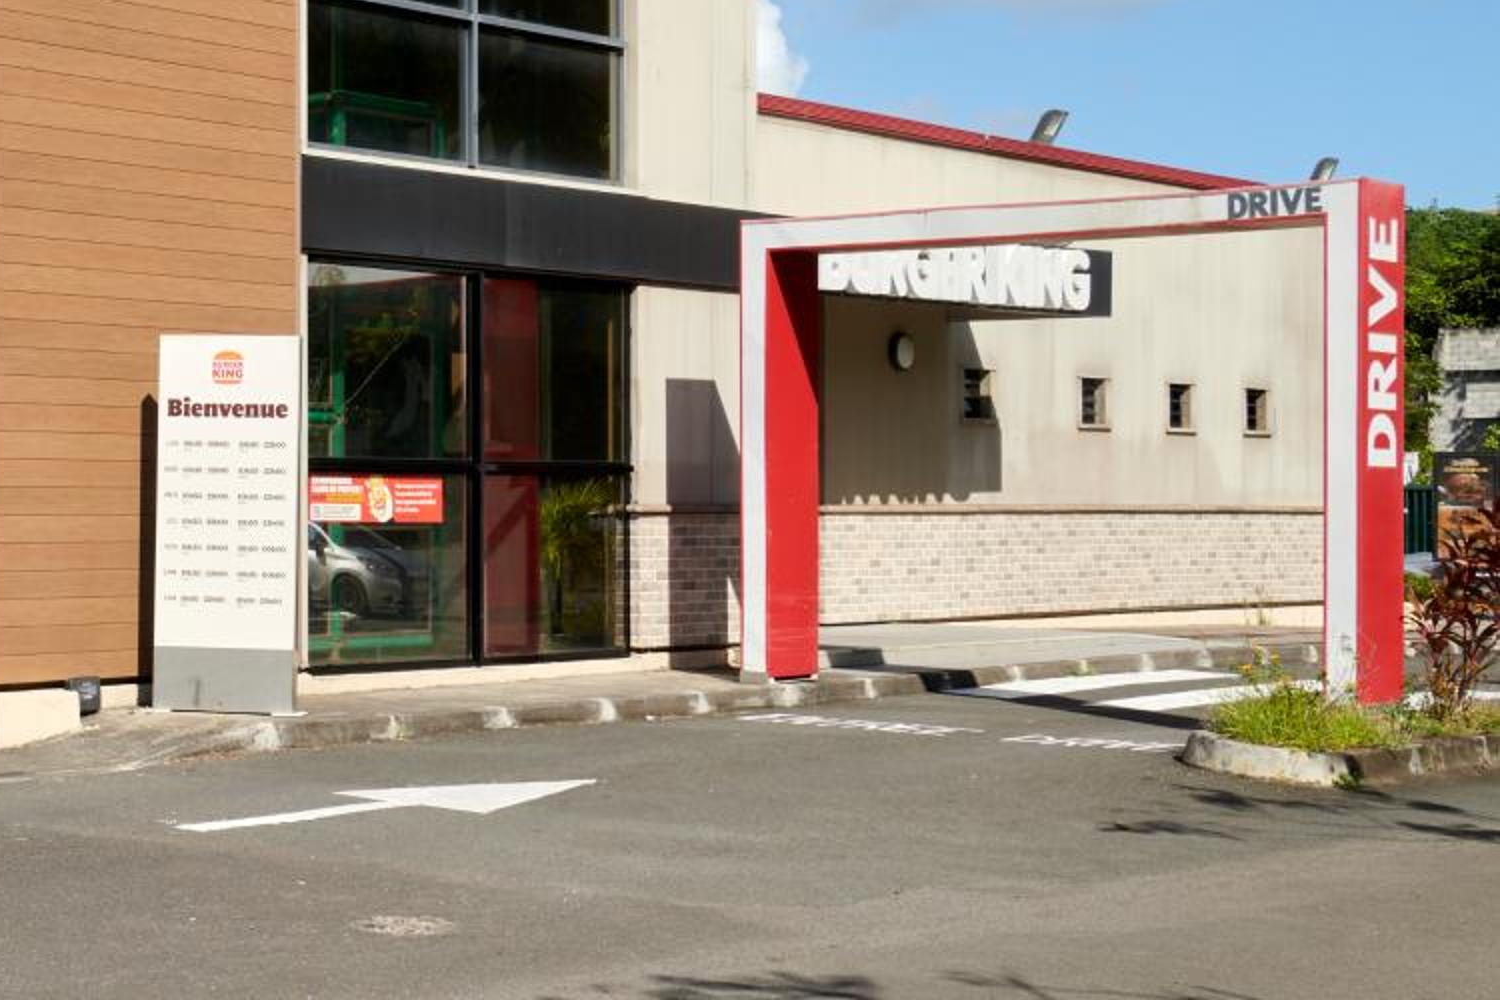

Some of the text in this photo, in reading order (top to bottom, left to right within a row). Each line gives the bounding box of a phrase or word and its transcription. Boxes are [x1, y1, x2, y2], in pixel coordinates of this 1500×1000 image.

[1227, 187, 1323, 220] DRIVE
[1367, 216, 1398, 468] DRIVE
[212, 369, 244, 379] KING
[167, 396, 289, 418] Bienvenue
